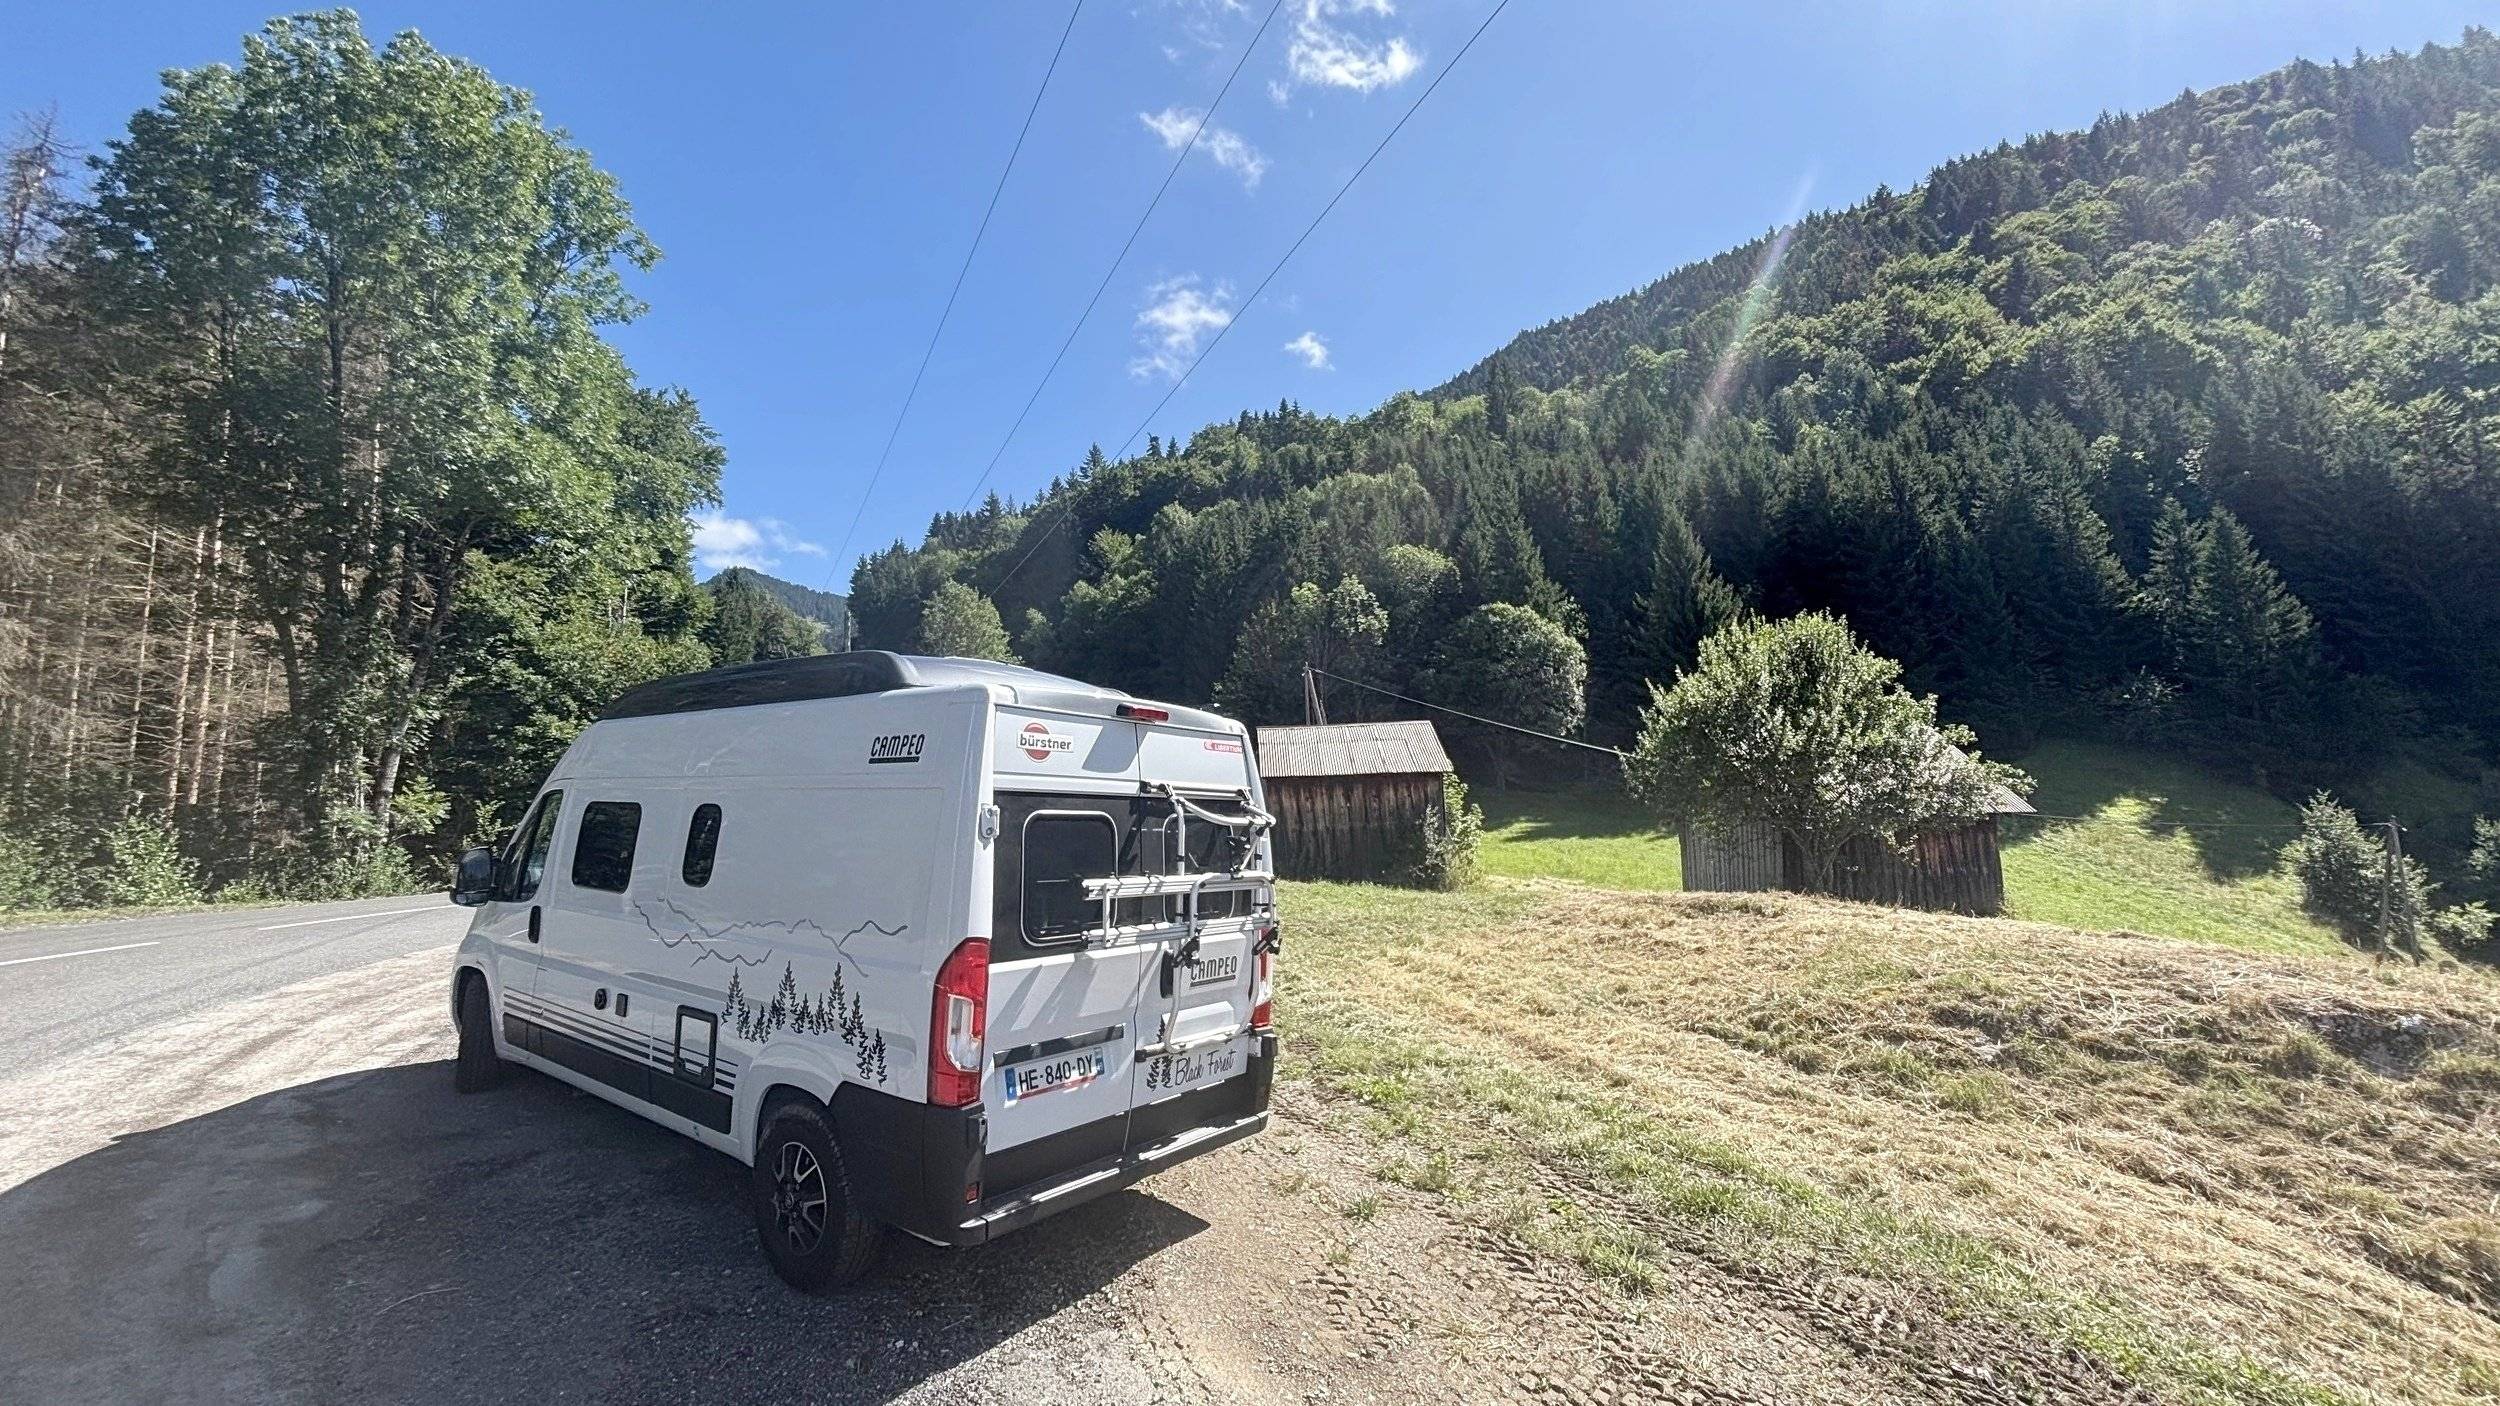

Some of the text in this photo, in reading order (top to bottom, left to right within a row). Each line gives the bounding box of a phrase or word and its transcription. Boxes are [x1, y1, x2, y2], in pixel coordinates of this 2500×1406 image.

[871, 734, 925, 757] CAMPEO
[1020, 734, 1072, 750] bürstner
[1175, 1049, 1236, 1085] Black Forest
